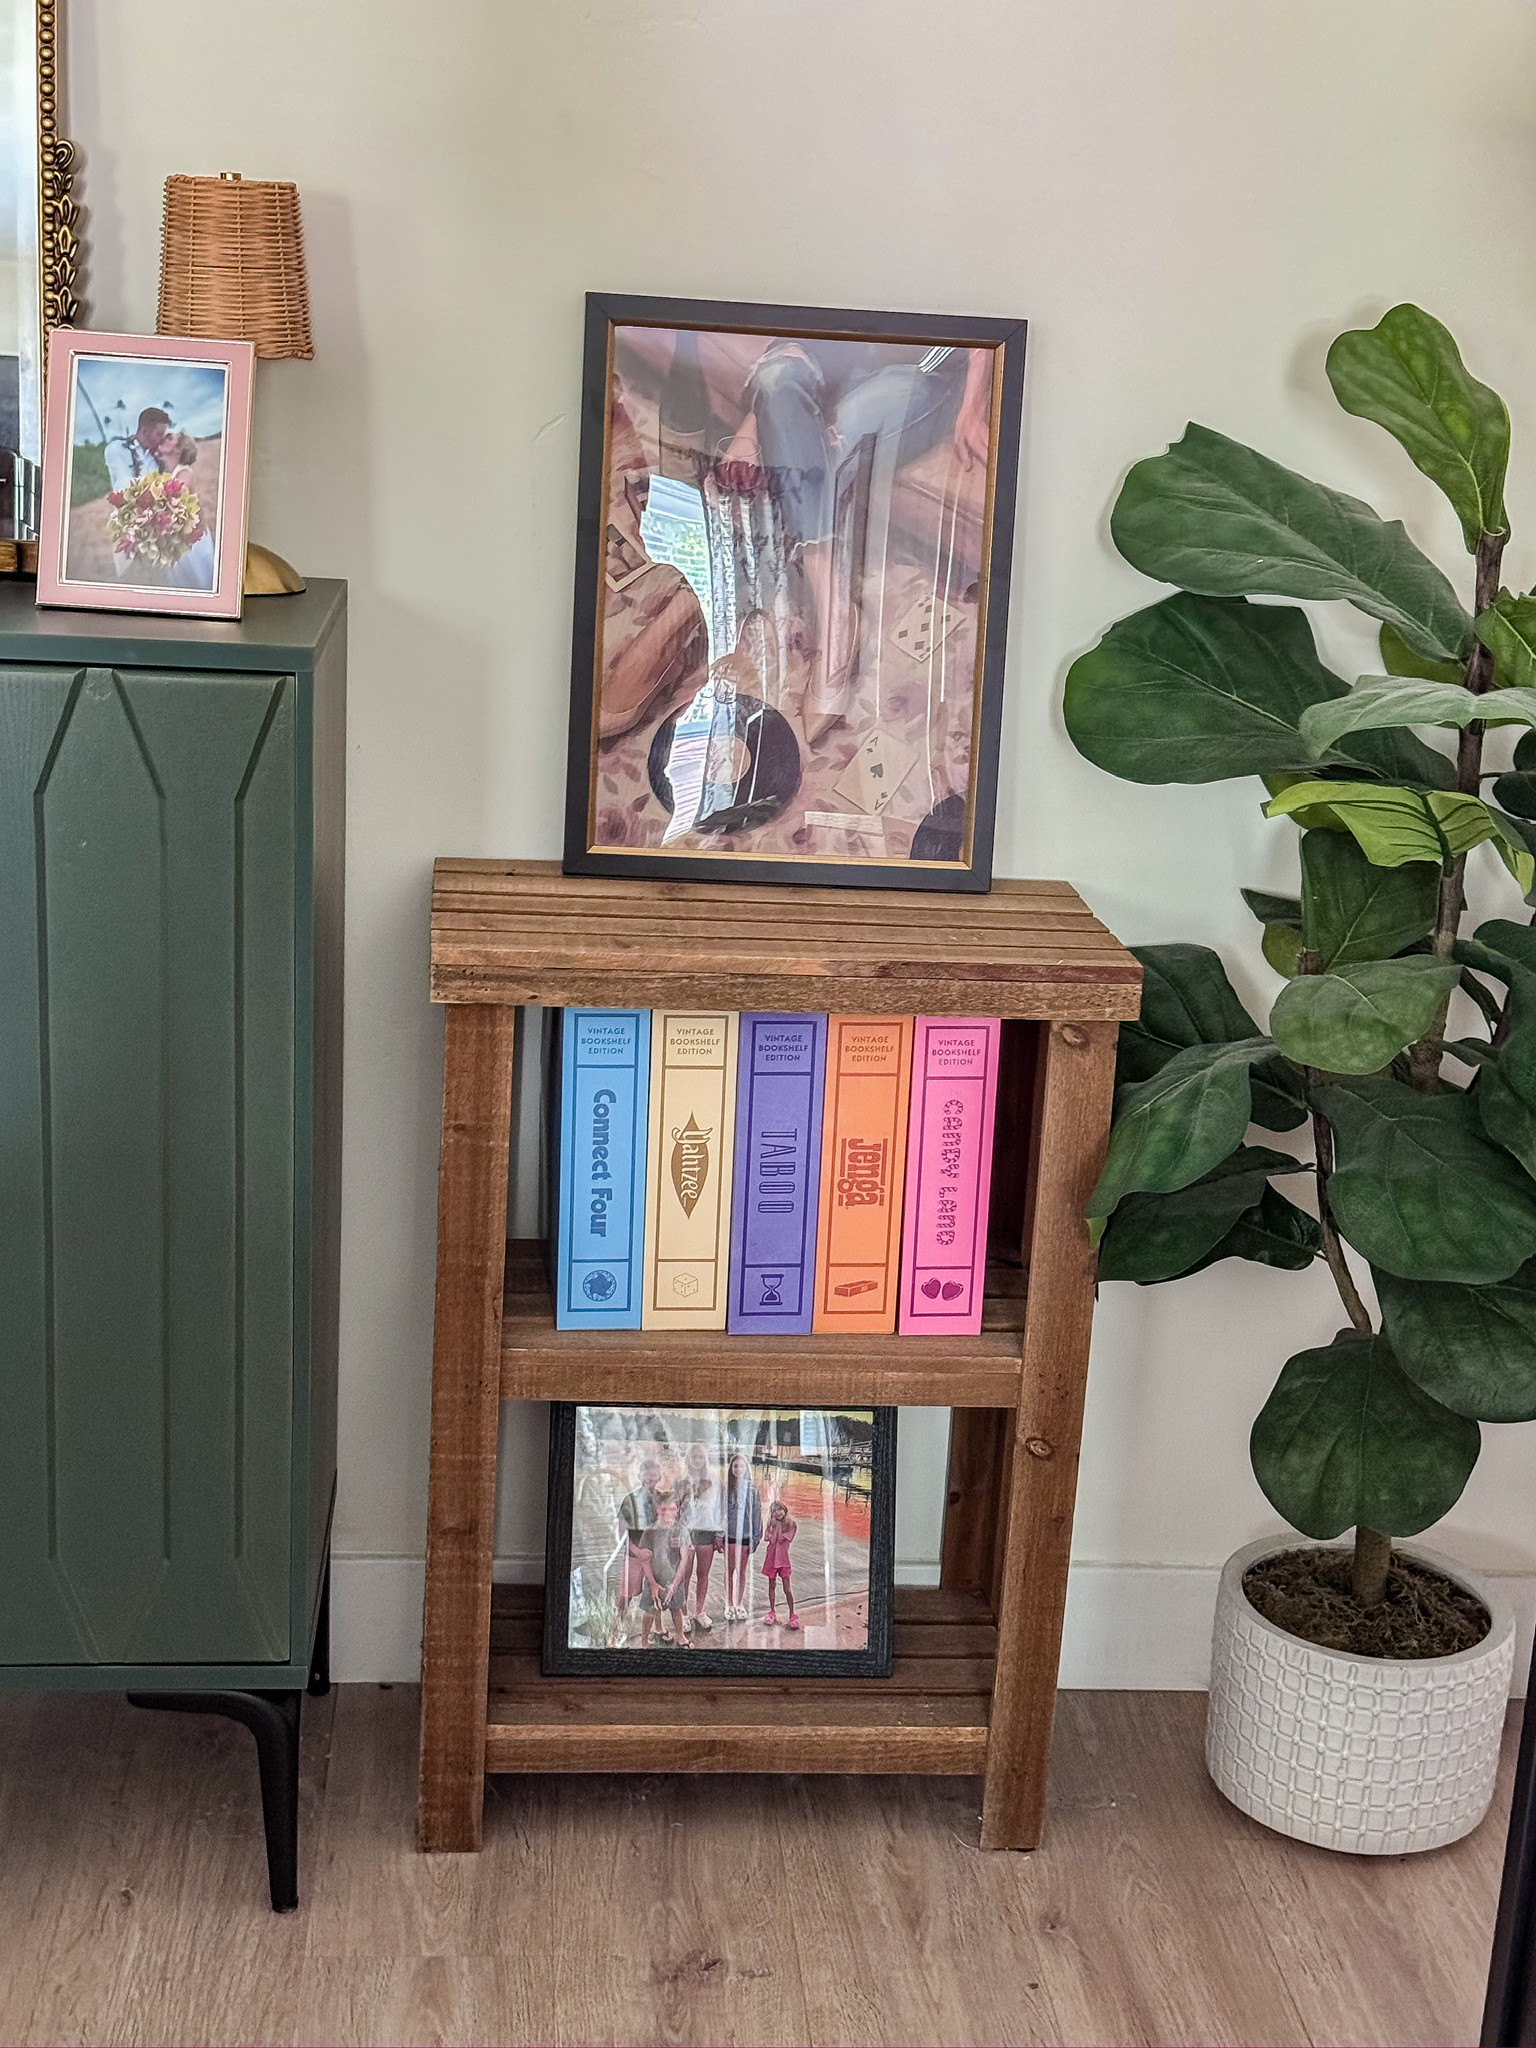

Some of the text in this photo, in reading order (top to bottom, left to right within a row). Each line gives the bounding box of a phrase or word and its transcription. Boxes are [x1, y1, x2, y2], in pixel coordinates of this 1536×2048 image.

[587, 1027, 626, 1035] VINTAGE
[676, 1028, 714, 1036] VINTAGE
[580, 1037, 632, 1045] BOOKSHELF
[670, 1038, 720, 1046] BOOKSHELF
[764, 1034, 803, 1043] VINTAGE
[851, 1035, 889, 1043] VINTAGE
[938, 1039, 975, 1047] VINTAGE
[588, 1047, 624, 1055] EDITION
[758, 1044, 808, 1052] BOOKSHELF
[845, 1045, 894, 1053] BOOKSHELF
[932, 1048, 981, 1056] BOOKSHELF
[765, 1054, 800, 1062] EDITION
[851, 1054, 887, 1062] EDITION
[938, 1058, 973, 1066] EDITION
[590, 1088, 617, 1238] Connect Four
[671, 1125, 713, 1200] Yahtzee
[758, 1128, 798, 1213] TABOO
[836, 1138, 885, 1207] Jenga
